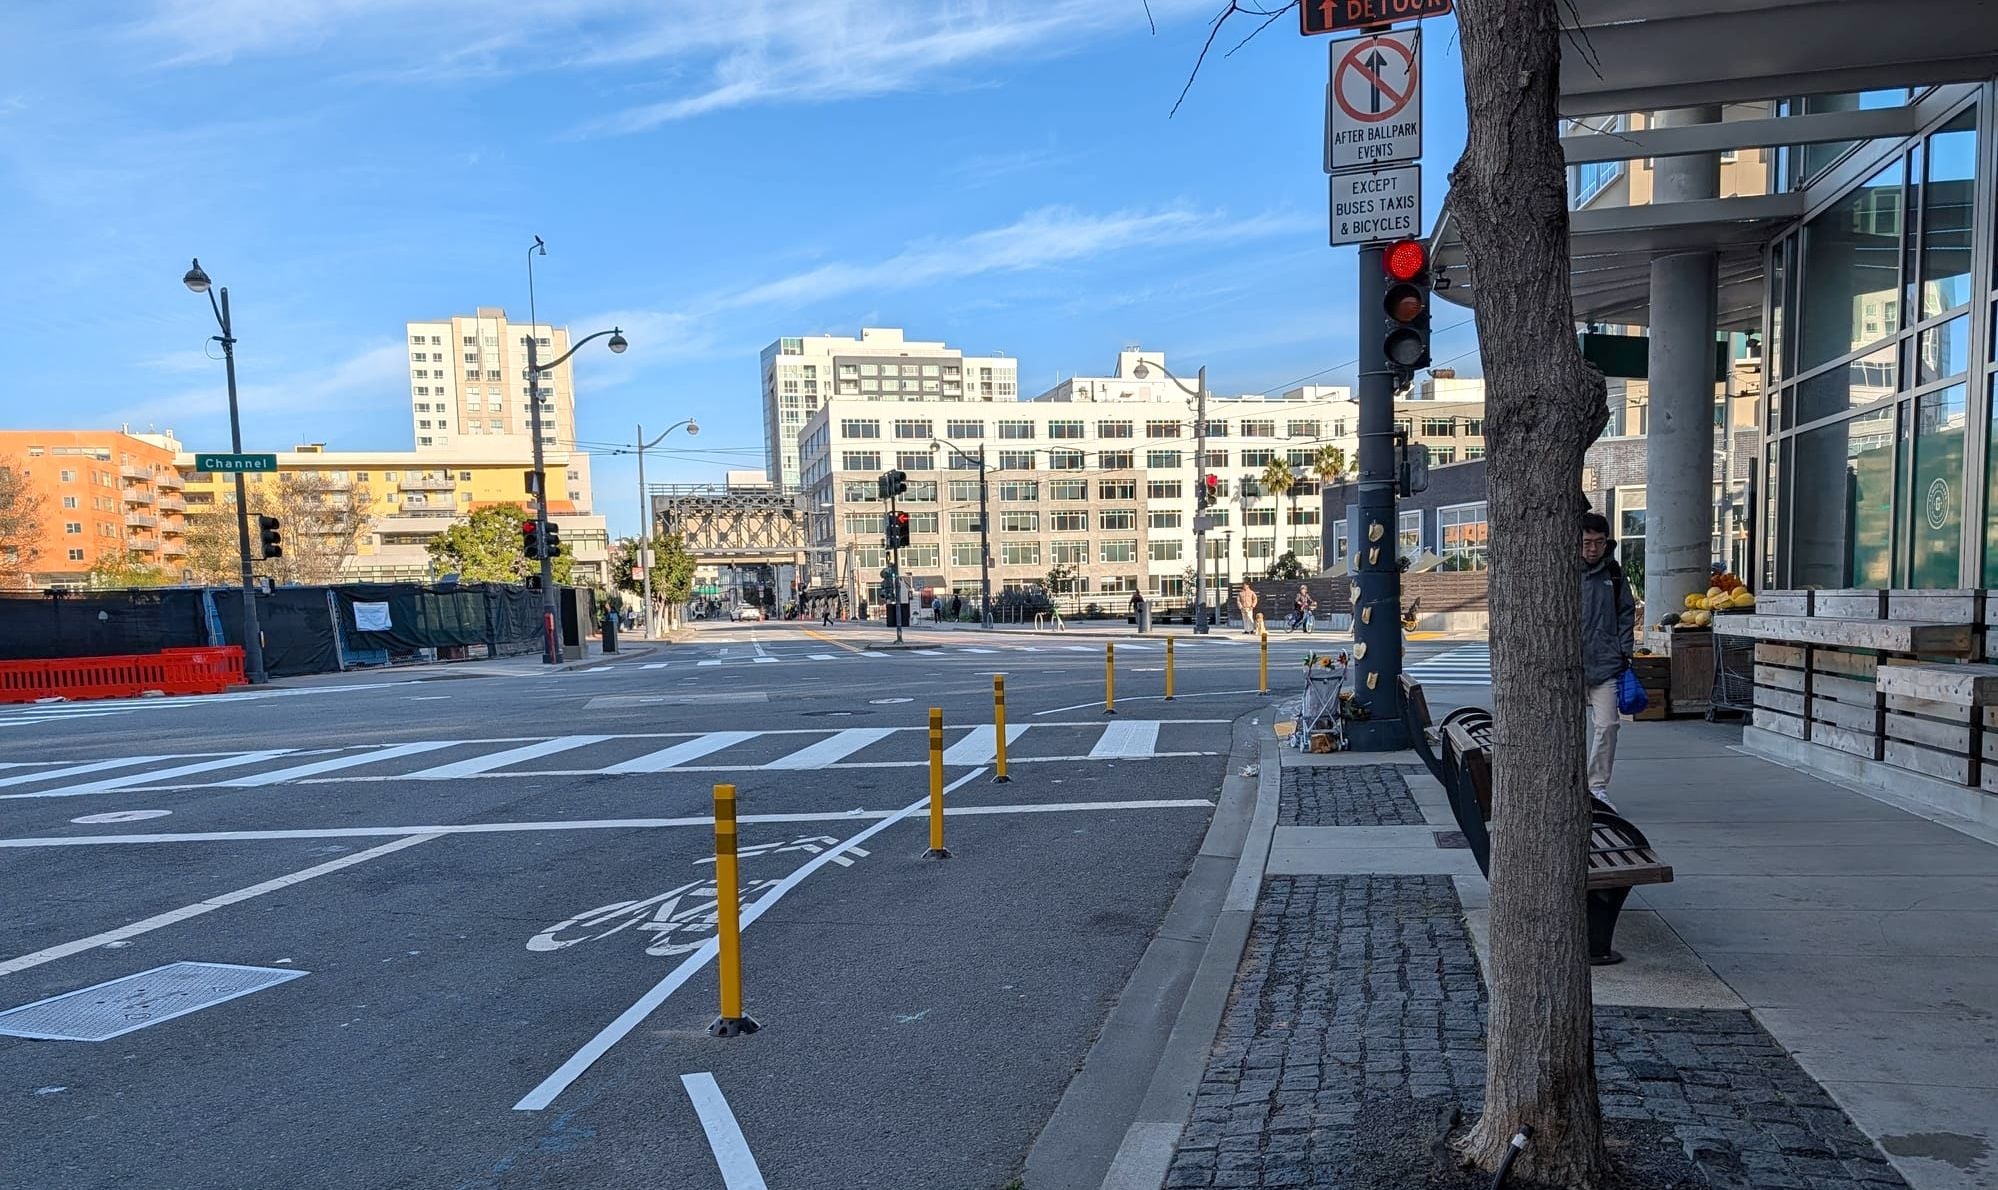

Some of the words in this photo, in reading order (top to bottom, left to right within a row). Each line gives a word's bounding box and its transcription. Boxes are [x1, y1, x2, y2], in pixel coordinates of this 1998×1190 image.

[1335, 129, 1364, 145] AFTER
[1368, 122, 1417, 141] BALLPARK
[1358, 142, 1393, 160] EVENTS
[1352, 177, 1398, 195] EXCEPT
[1336, 200, 1375, 216] BUSES
[1379, 195, 1415, 212] TAXIS
[1341, 222, 1348, 235] &
[1353, 215, 1410, 234] BICYCLES
[205, 458, 267, 469] Channel
